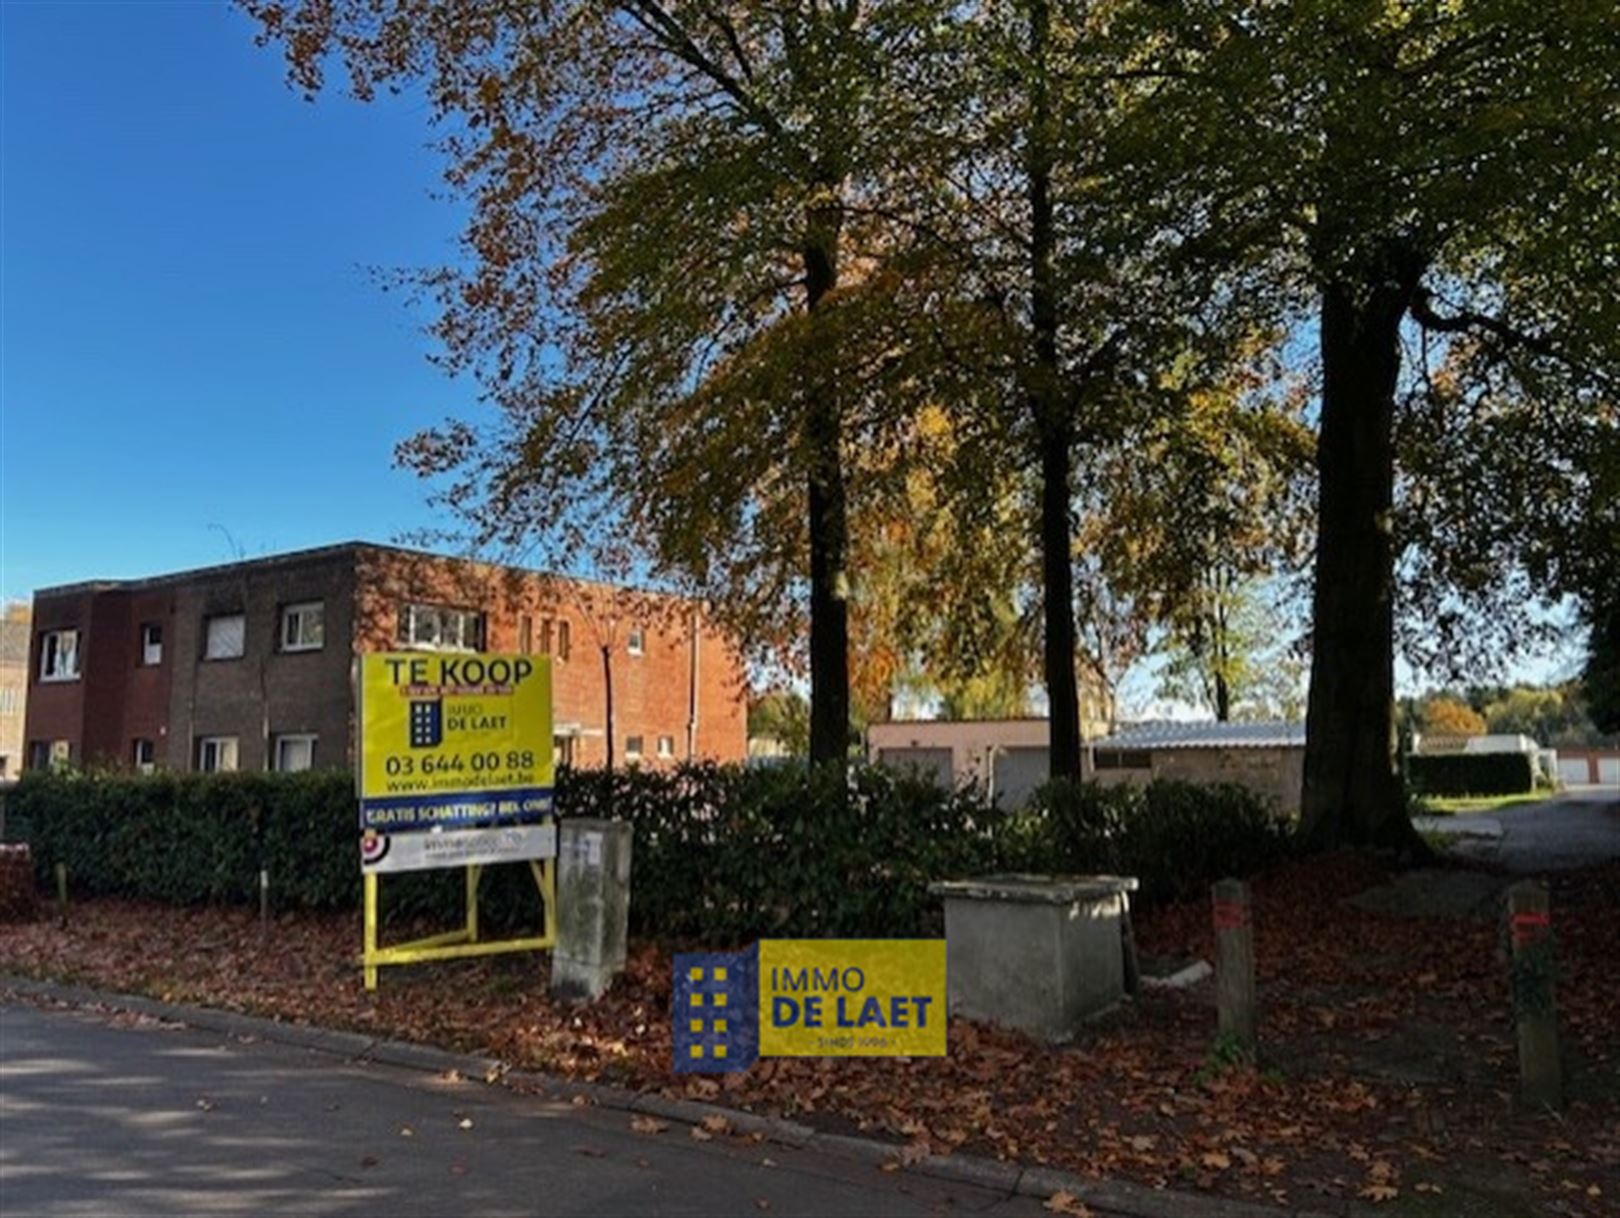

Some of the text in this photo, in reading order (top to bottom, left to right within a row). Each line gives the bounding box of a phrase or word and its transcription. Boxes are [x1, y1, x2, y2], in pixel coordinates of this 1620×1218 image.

[385, 659, 533, 687] TE KOOP
[447, 716, 507, 731] DE LAET
[386, 750, 534, 776] 03 644 00 88
[366, 808, 415, 824] GRATIS
